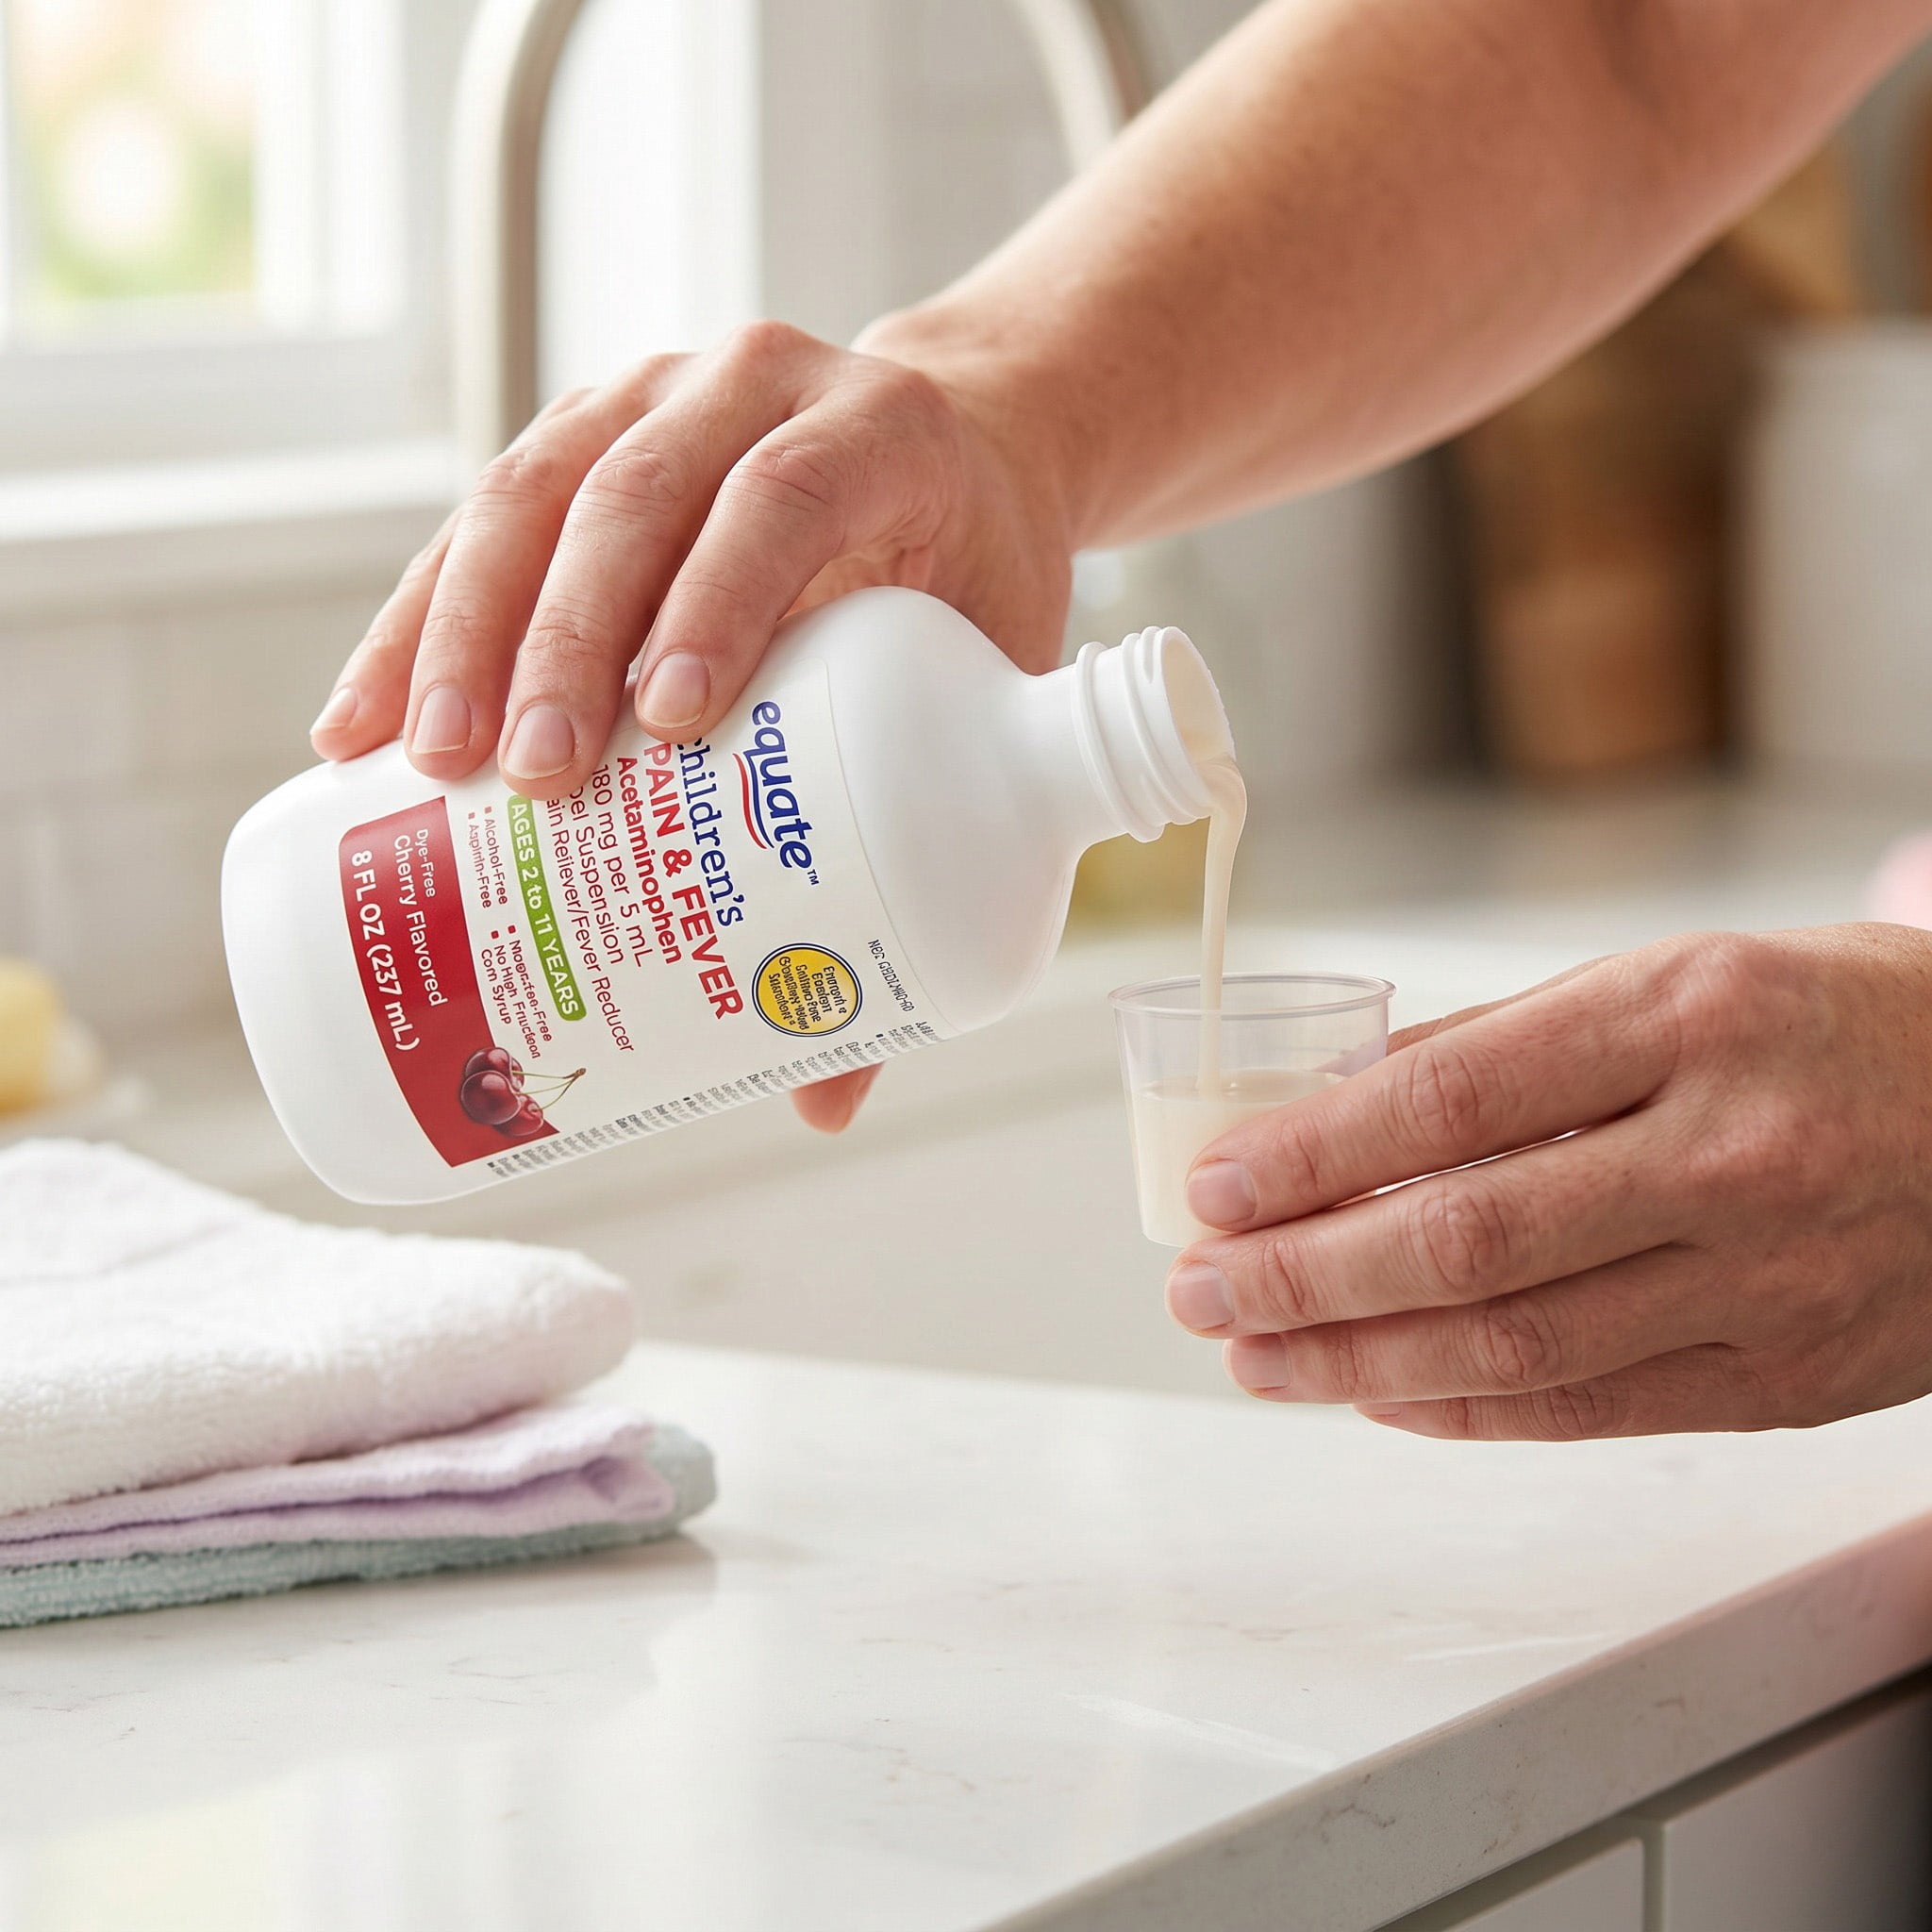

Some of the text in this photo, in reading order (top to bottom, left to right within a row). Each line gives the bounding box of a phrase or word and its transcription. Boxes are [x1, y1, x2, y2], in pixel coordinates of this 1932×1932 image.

[415, 829, 435, 897] Dye-Free
[485, 820, 508, 904] Alcohol-Free
[591, 764, 653, 967] 180 mg per 5 mL
[617, 758, 681, 963] Acetaminophen
[743, 702, 812, 868] equate
[352, 851, 419, 1050] 8 FL OZ (237 mL)
[394, 835, 447, 1006] Cherry Flavored
[494, 945, 506, 964] No
[511, 804, 578, 1014] AGES 2 to 11 YEARS
[644, 742, 743, 1019] PAIN & FEVER
[492, 985, 511, 1024] Syrup
[592, 977, 634, 1050] Reducer
